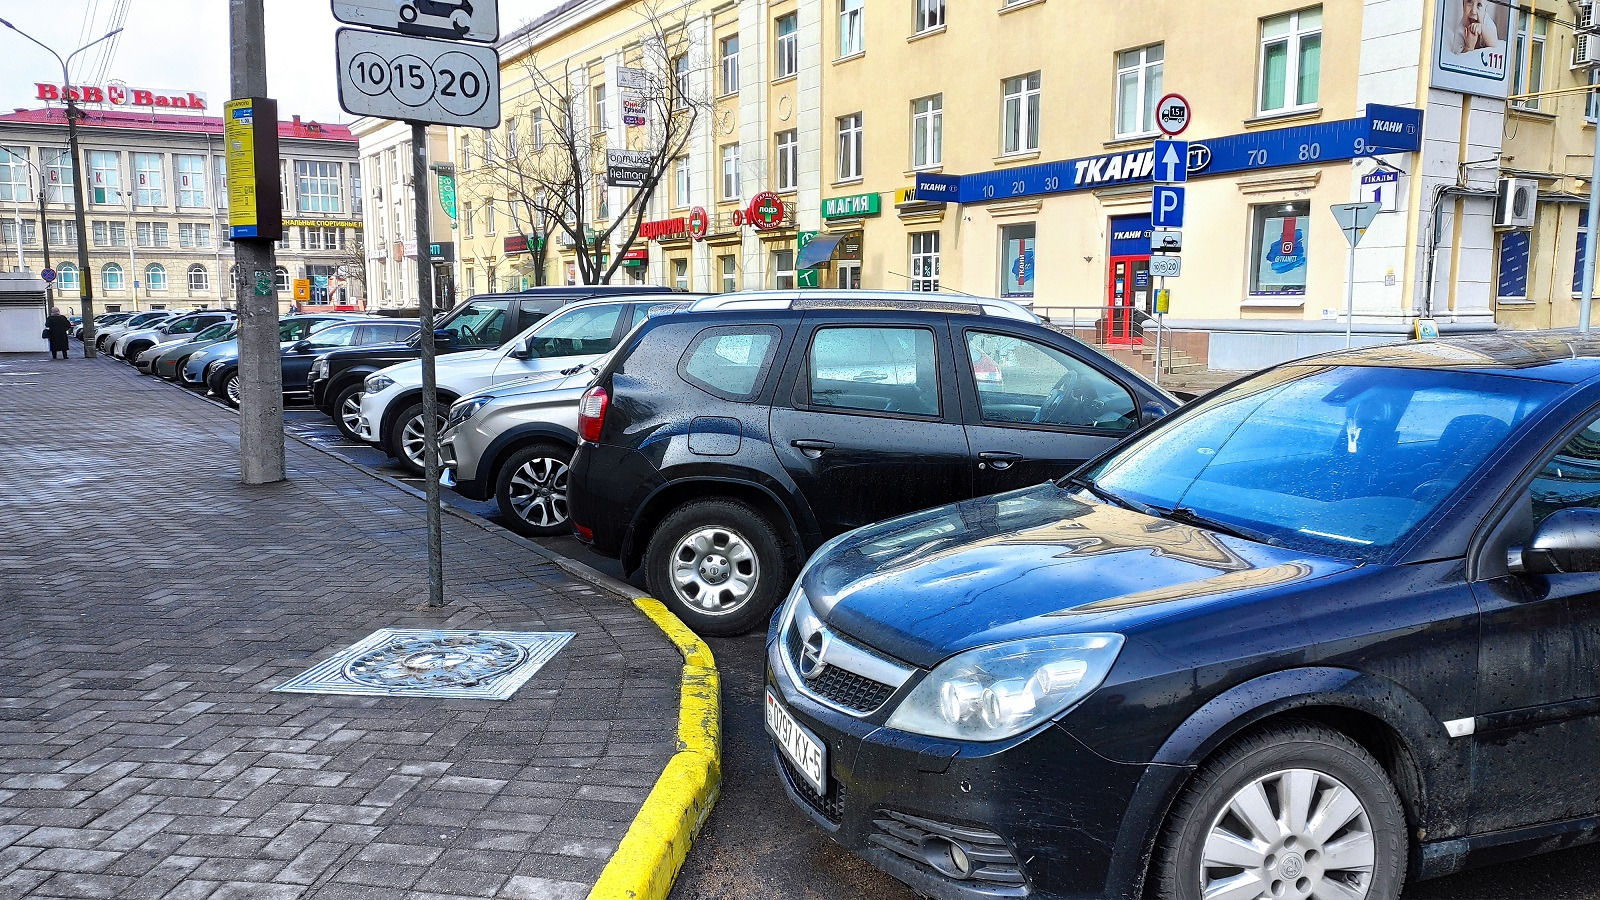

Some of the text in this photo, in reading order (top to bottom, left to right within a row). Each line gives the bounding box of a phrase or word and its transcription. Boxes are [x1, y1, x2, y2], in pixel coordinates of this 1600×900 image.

[1489, 52, 1503, 69] 111
[357, 61, 480, 98] 10 15 20
[131, 89, 206, 109] Bank
[1372, 119, 1404, 133] ТКАНИ
[1247, 149, 1268, 166] 70
[1299, 142, 1321, 160] 80
[920, 182, 947, 192] ТКАНИ
[982, 176, 1059, 198] 10 20 30
[1371, 185, 1382, 203] 1
[826, 195, 870, 215] МАГИЯ
[1160, 190, 1178, 222] P
[1114, 230, 1142, 240] ТКАНИ
[1168, 262, 1177, 270] 20
[773, 703, 792, 747] 0797
